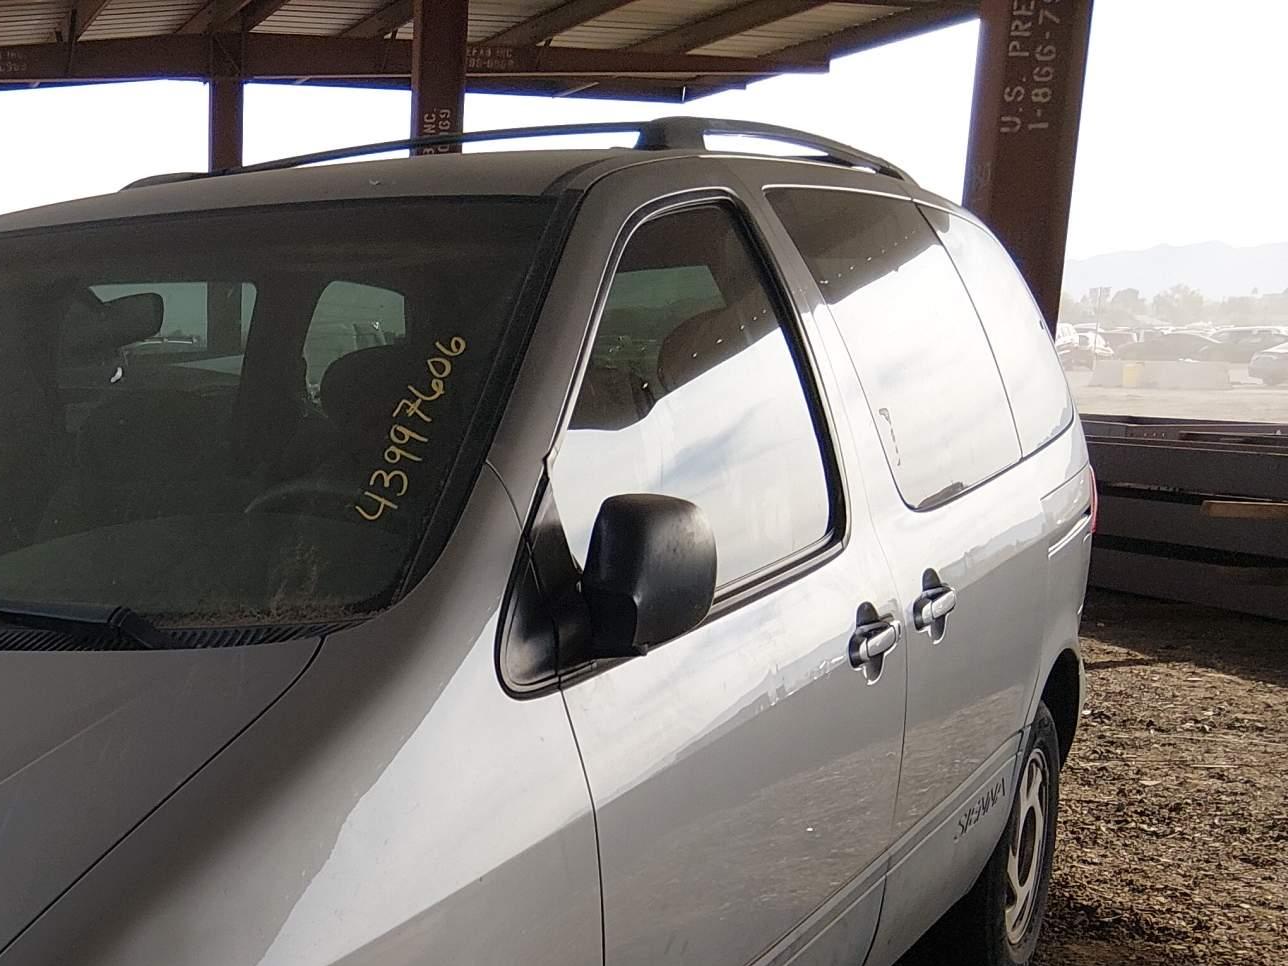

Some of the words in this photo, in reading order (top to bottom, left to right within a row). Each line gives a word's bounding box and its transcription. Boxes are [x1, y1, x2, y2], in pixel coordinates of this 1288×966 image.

[999, 76, 1027, 133] U.S.
[1027, 0, 1061, 131] 1-866-7
[355, 335, 467, 520] 43997606
